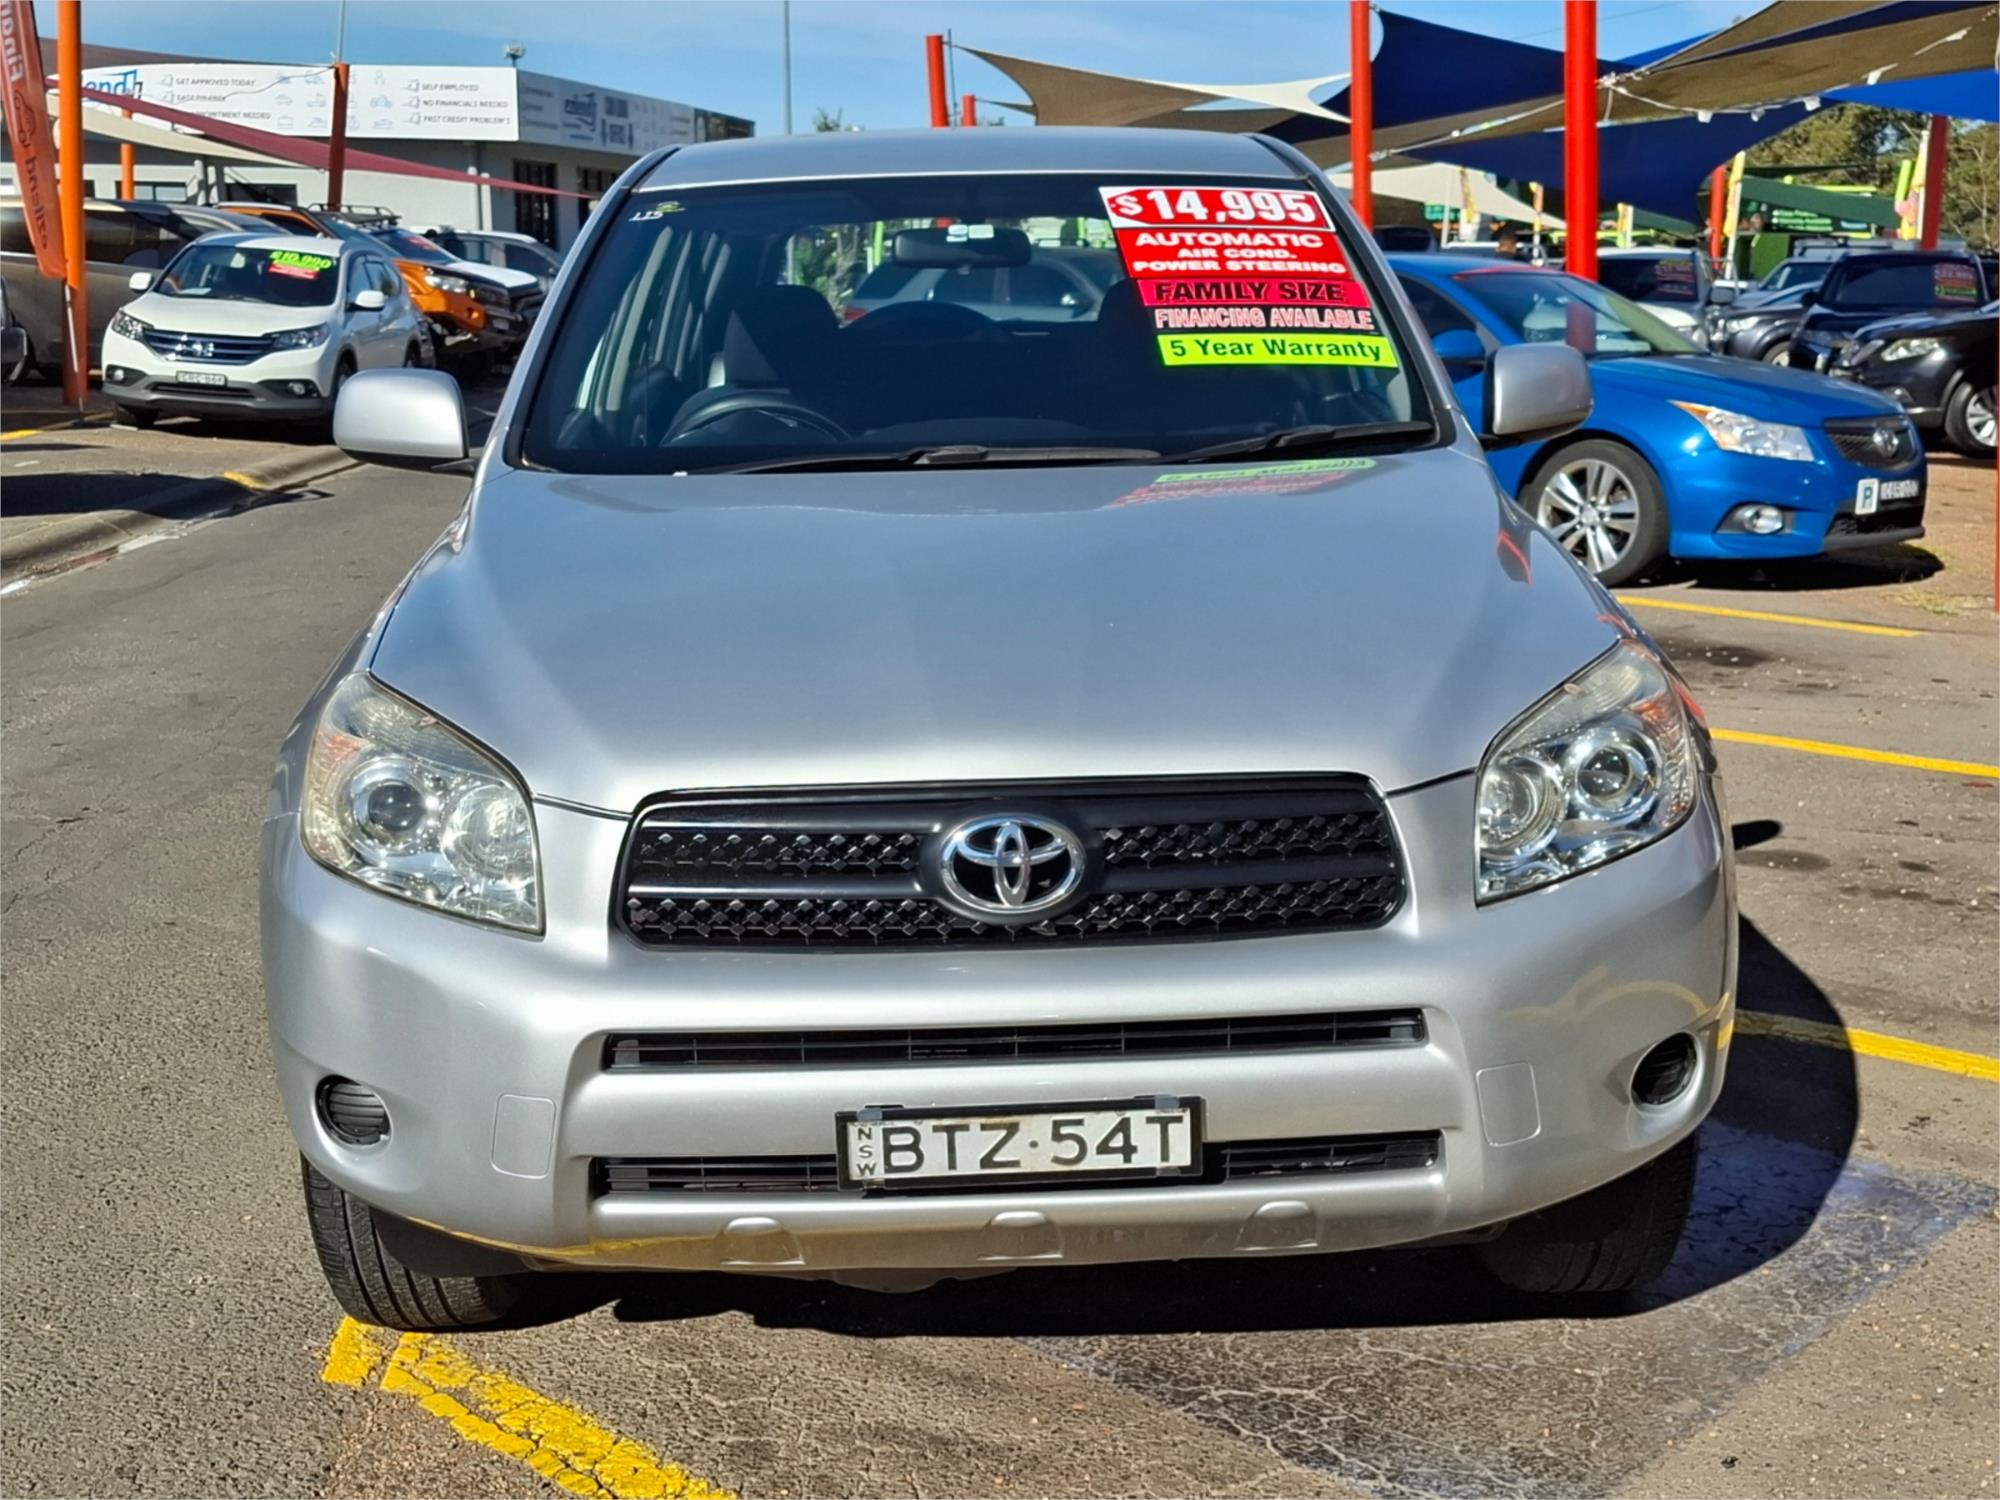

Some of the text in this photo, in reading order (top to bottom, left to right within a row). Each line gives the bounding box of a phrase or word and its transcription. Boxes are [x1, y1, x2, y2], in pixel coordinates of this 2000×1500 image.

[191, 78, 229, 86] APPROVED
[231, 79, 256, 87] TODAY
[439, 84, 479, 92] EMPLOYED
[435, 100, 477, 108] FINANCIALS
[242, 111, 272, 120] NEEDED
[442, 115, 468, 123] CREDIT
[1135, 232, 1324, 248] AUTOMATIC
[1177, 248, 1297, 259] AIR COND.
[1132, 260, 1347, 274] POWER STEERING
[1154, 281, 1345, 302] FAMILY SIZE
[1154, 307, 1375, 331] FINANCING AVAILABLE
[1170, 338, 1381, 362] 5 Year Warranty
[1862, 486, 1874, 509] P
